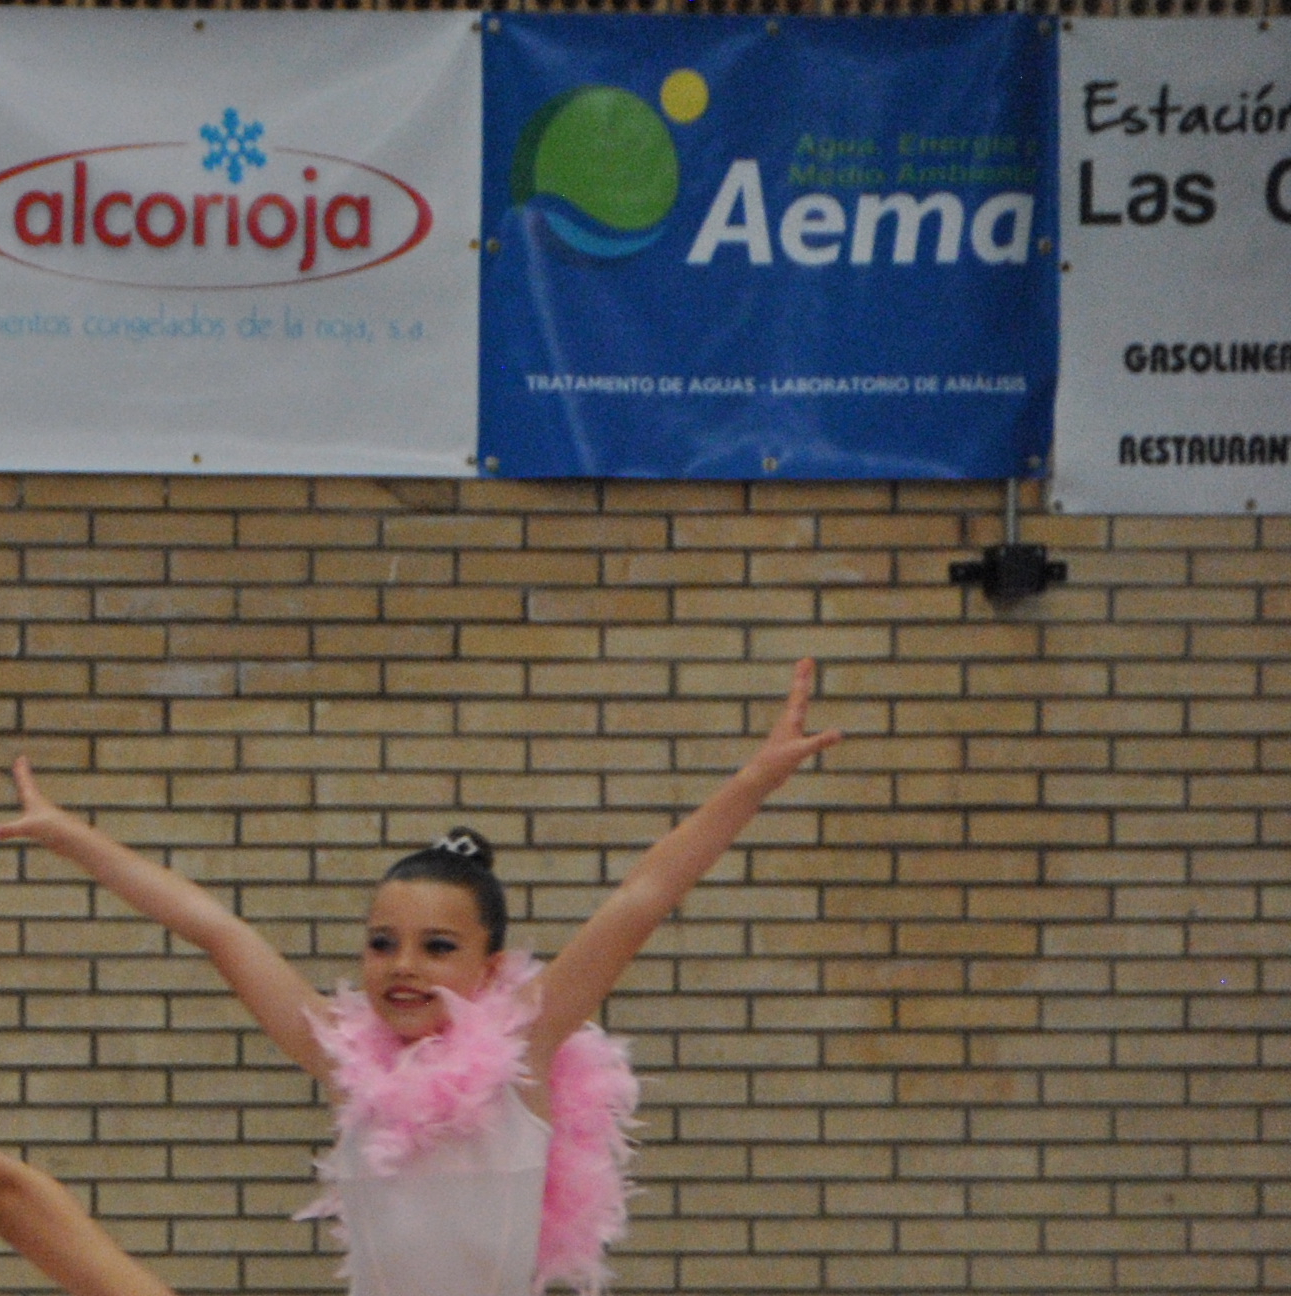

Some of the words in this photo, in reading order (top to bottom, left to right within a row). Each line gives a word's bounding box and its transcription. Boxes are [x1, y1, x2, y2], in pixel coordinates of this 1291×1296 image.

[14, 160, 371, 273] alcorioja
[686, 159, 1035, 266] Aema
[1080, 159, 1217, 227] Las
[526, 374, 655, 394] TRATAMIENTO
[658, 376, 683, 394] DE
[688, 376, 756, 394] AGUAS
[771, 376, 910, 396] LABORATORIO
[914, 376, 940, 394] DE
